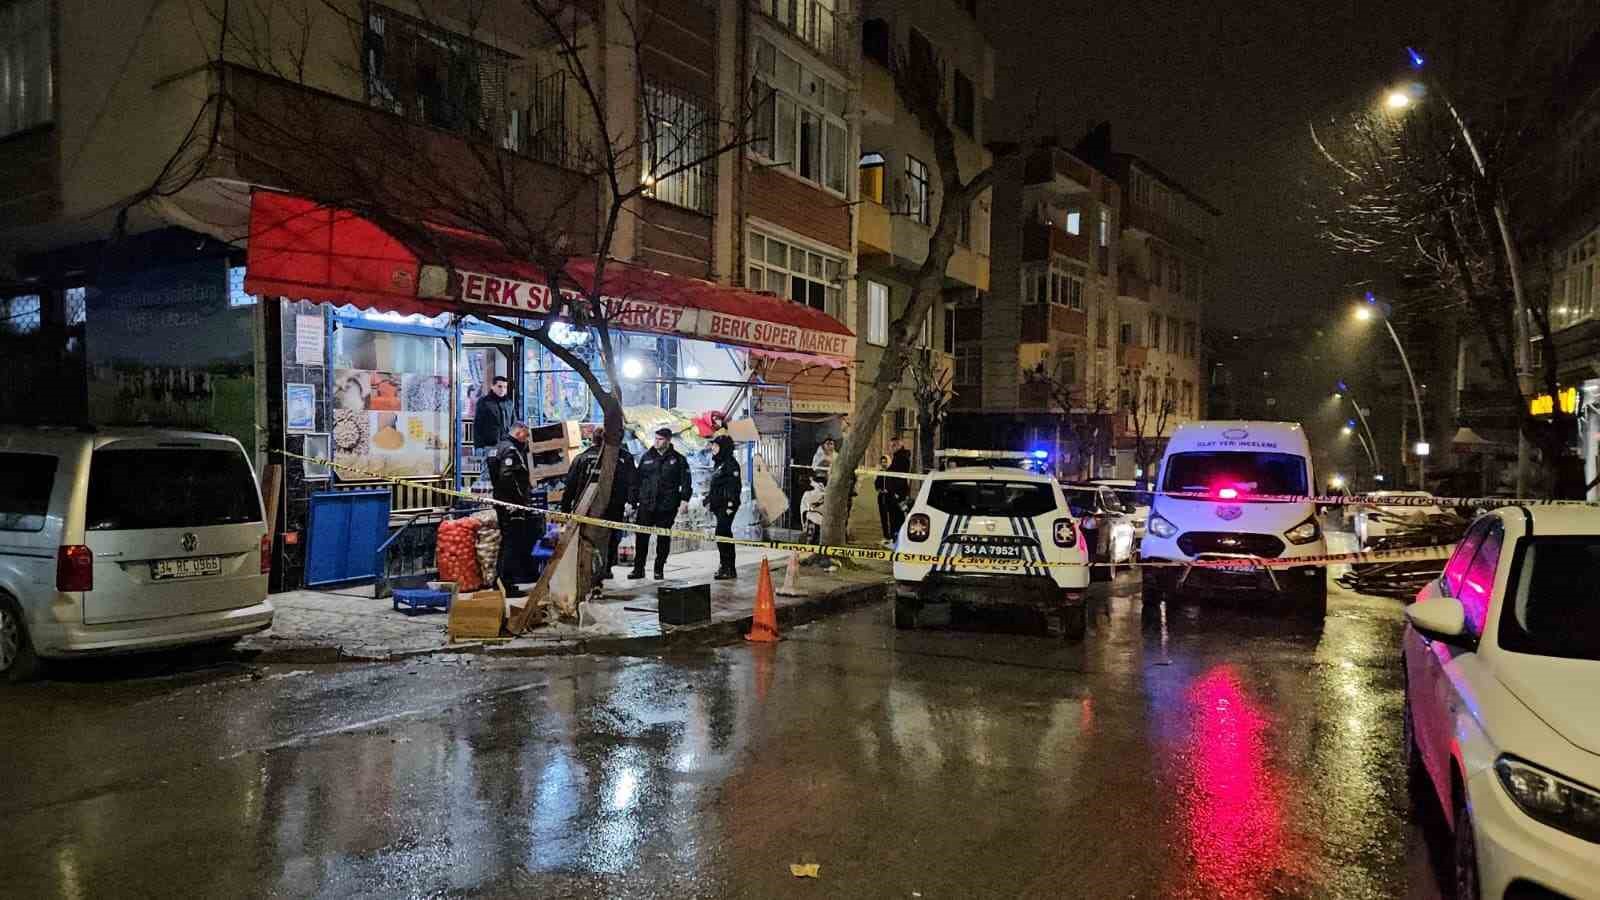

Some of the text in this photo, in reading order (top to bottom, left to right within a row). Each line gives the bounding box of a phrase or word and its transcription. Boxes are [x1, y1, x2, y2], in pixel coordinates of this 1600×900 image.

[710, 315, 752, 339] BERK
[799, 329, 849, 353] MARKET
[964, 545, 1019, 555] 34 A 79521
[160, 560, 172, 573] 34
